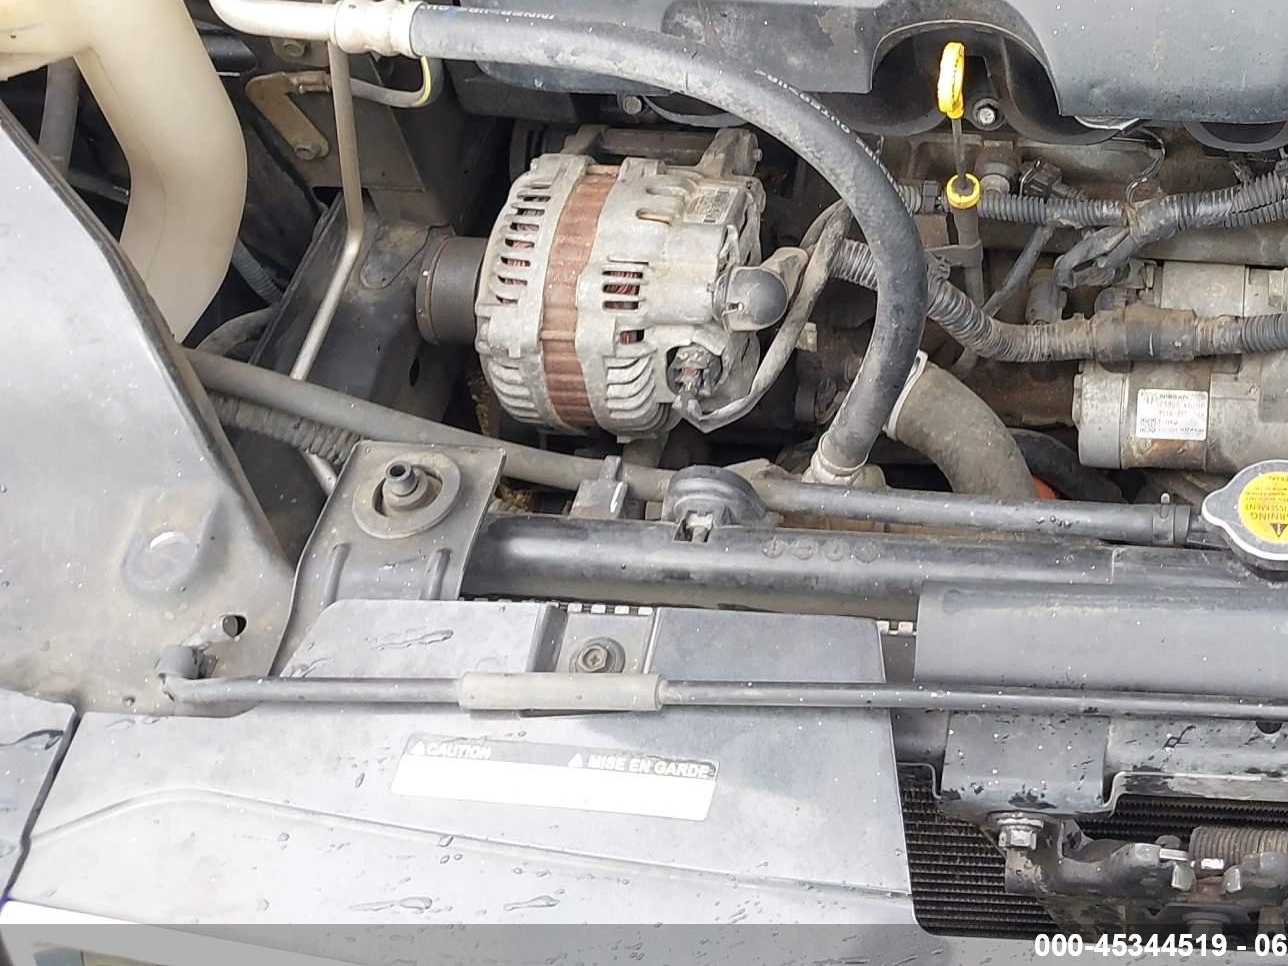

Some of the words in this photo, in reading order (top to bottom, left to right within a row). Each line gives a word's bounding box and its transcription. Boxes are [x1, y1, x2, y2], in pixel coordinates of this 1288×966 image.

[427, 742, 492, 760] CAUTION
[588, 753, 626, 772] MISE
[628, 757, 652, 775] EN
[653, 760, 710, 779] GARDE
